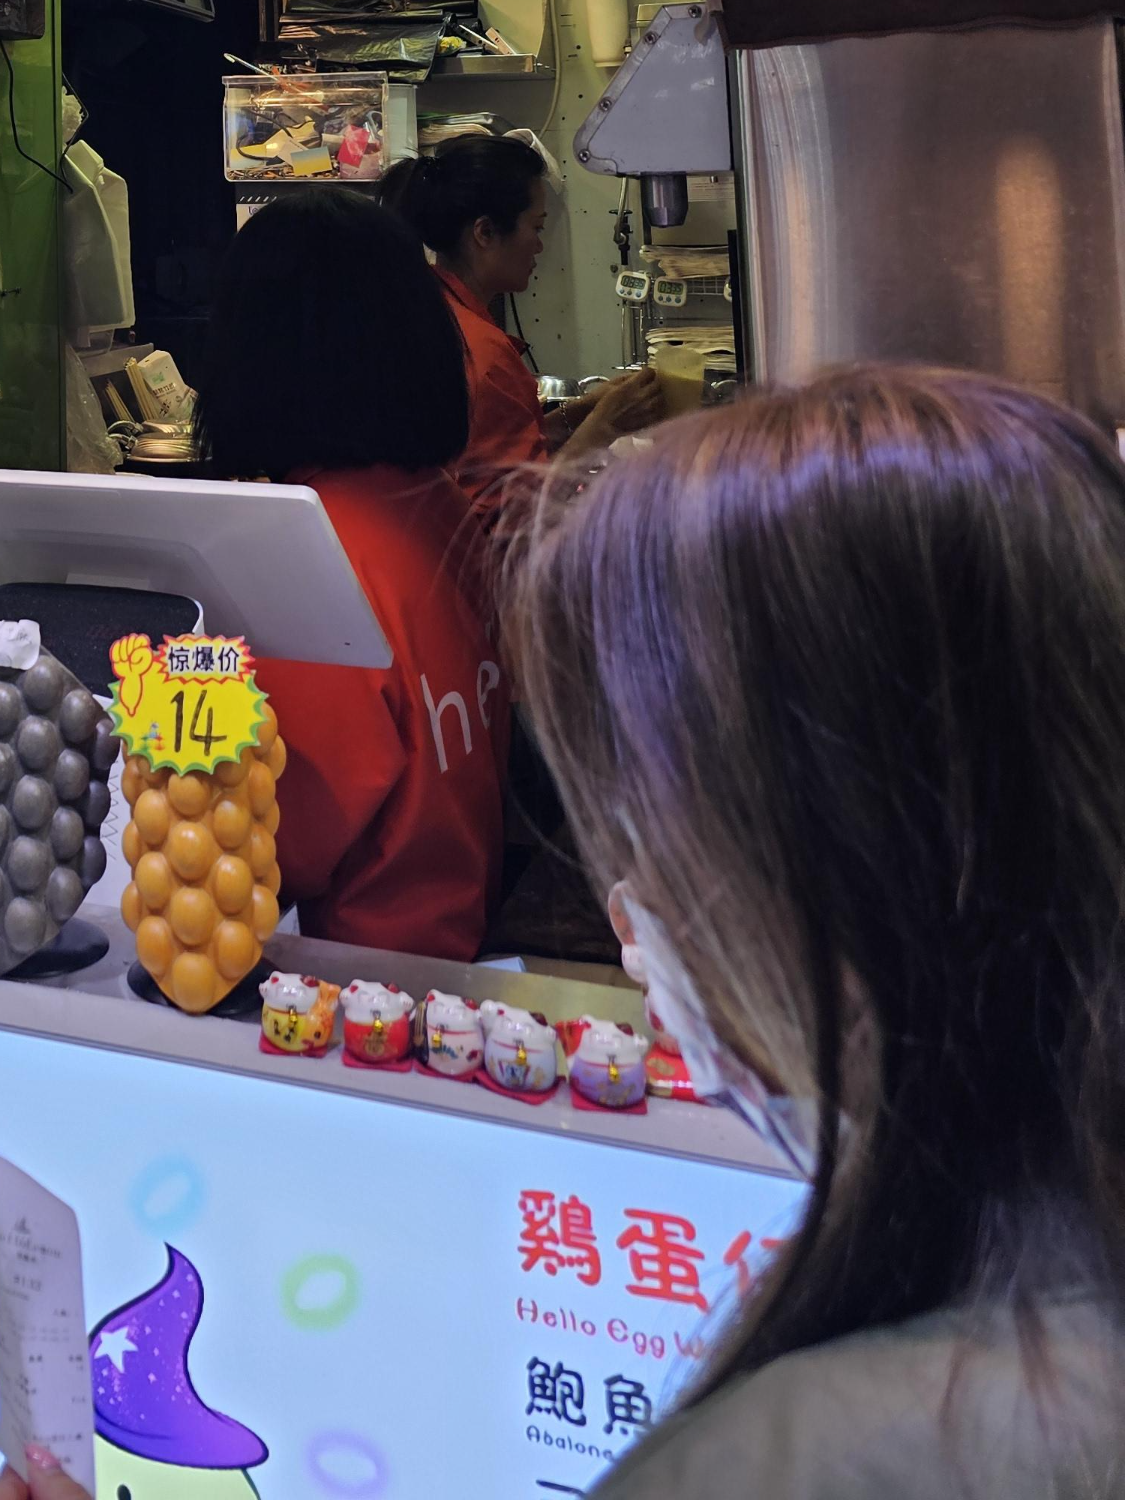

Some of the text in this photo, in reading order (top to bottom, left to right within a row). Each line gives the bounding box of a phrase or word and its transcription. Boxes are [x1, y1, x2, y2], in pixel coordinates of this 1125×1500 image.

[168, 645, 240, 672] 惊爆价
[170, 689, 228, 757] 14
[516, 1297, 597, 1336] Hello
[607, 1317, 665, 1359] Egg
[525, 1355, 653, 1436] 鮑魚
[526, 1424, 614, 1460] Abalone
